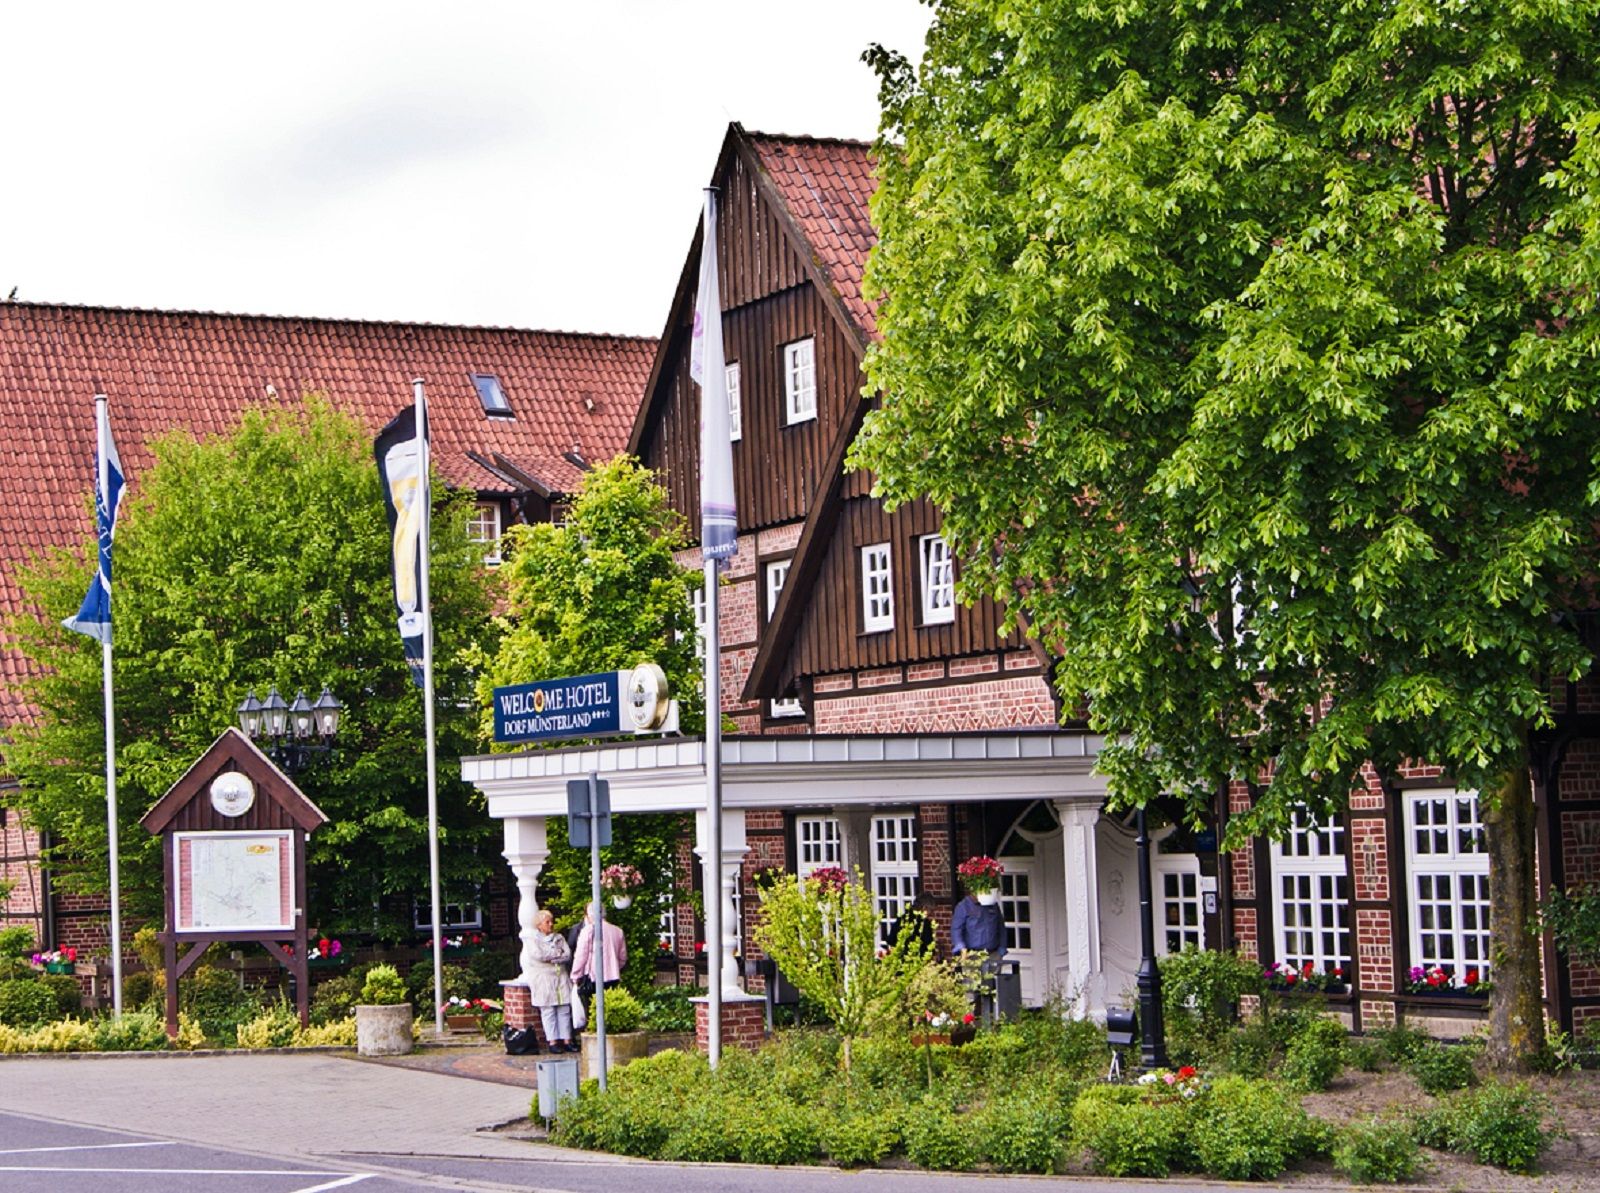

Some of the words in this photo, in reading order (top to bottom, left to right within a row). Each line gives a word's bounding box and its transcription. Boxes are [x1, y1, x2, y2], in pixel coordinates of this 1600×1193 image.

[501, 688, 563, 715] WELCOME
[566, 682, 611, 708] HOTEL
[504, 717, 526, 735] DORF
[527, 712, 591, 733] MÜNSTERLAND
